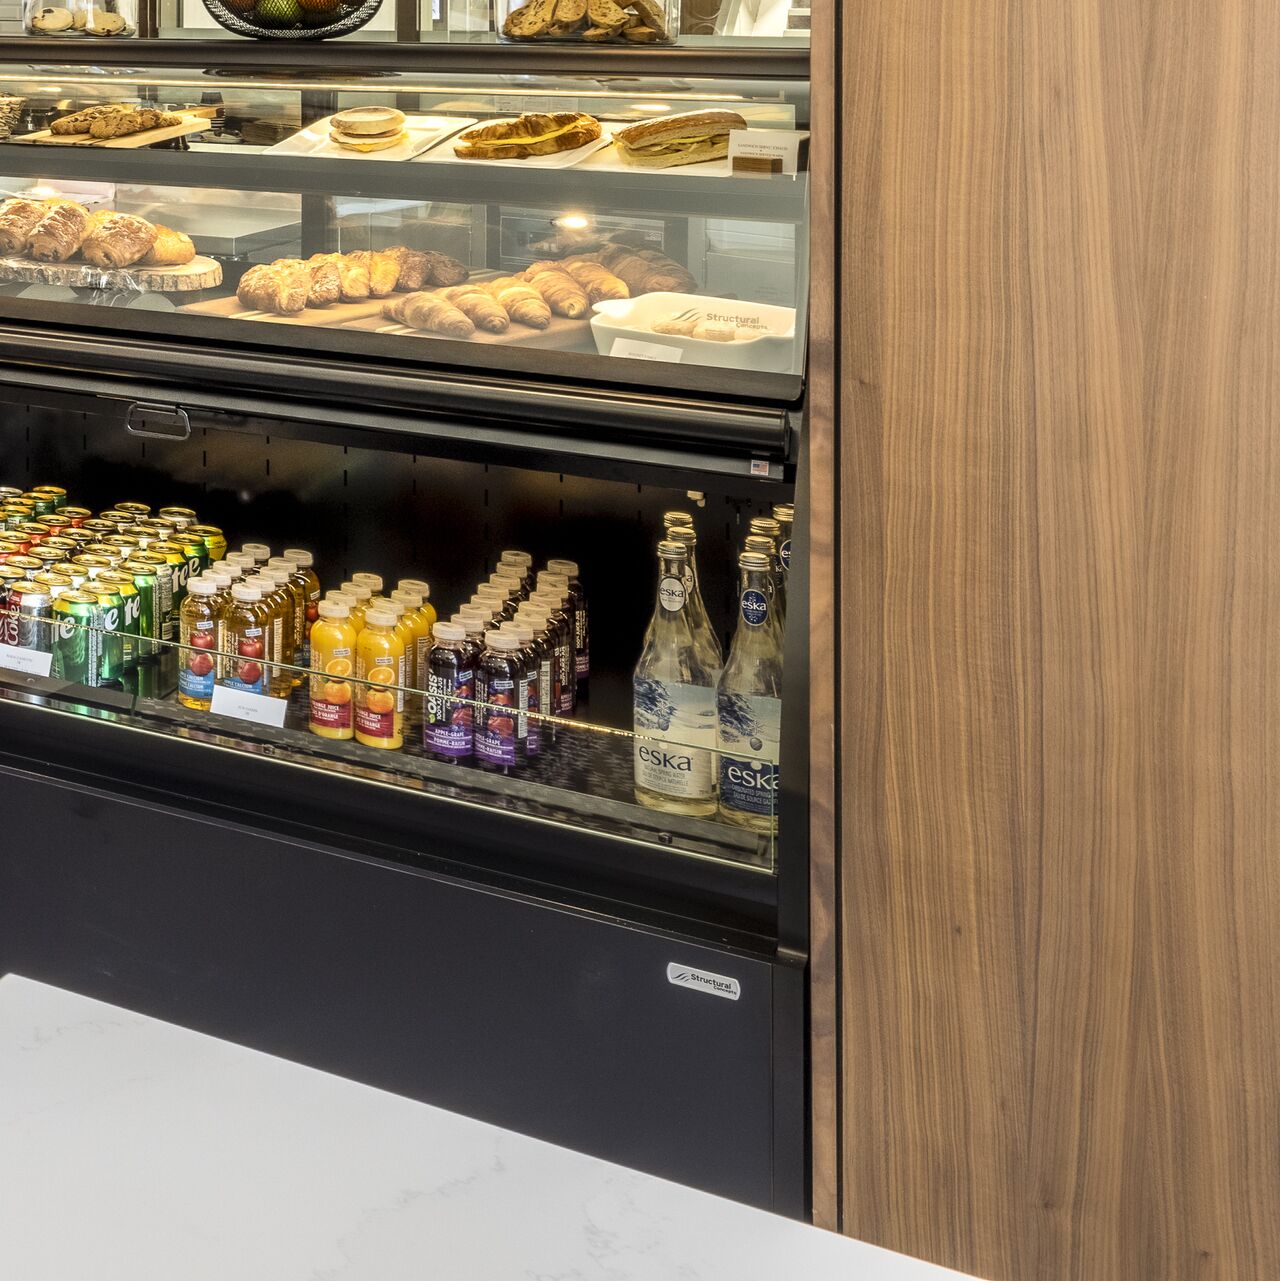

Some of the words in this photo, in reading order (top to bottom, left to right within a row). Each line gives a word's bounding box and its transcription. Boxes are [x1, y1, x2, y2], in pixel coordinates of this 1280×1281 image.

[706, 313, 760, 325] Structural
[659, 587, 685, 598] eska
[741, 599, 768, 611] eska
[639, 745, 691, 772] eska
[690, 973, 733, 990] Structural
